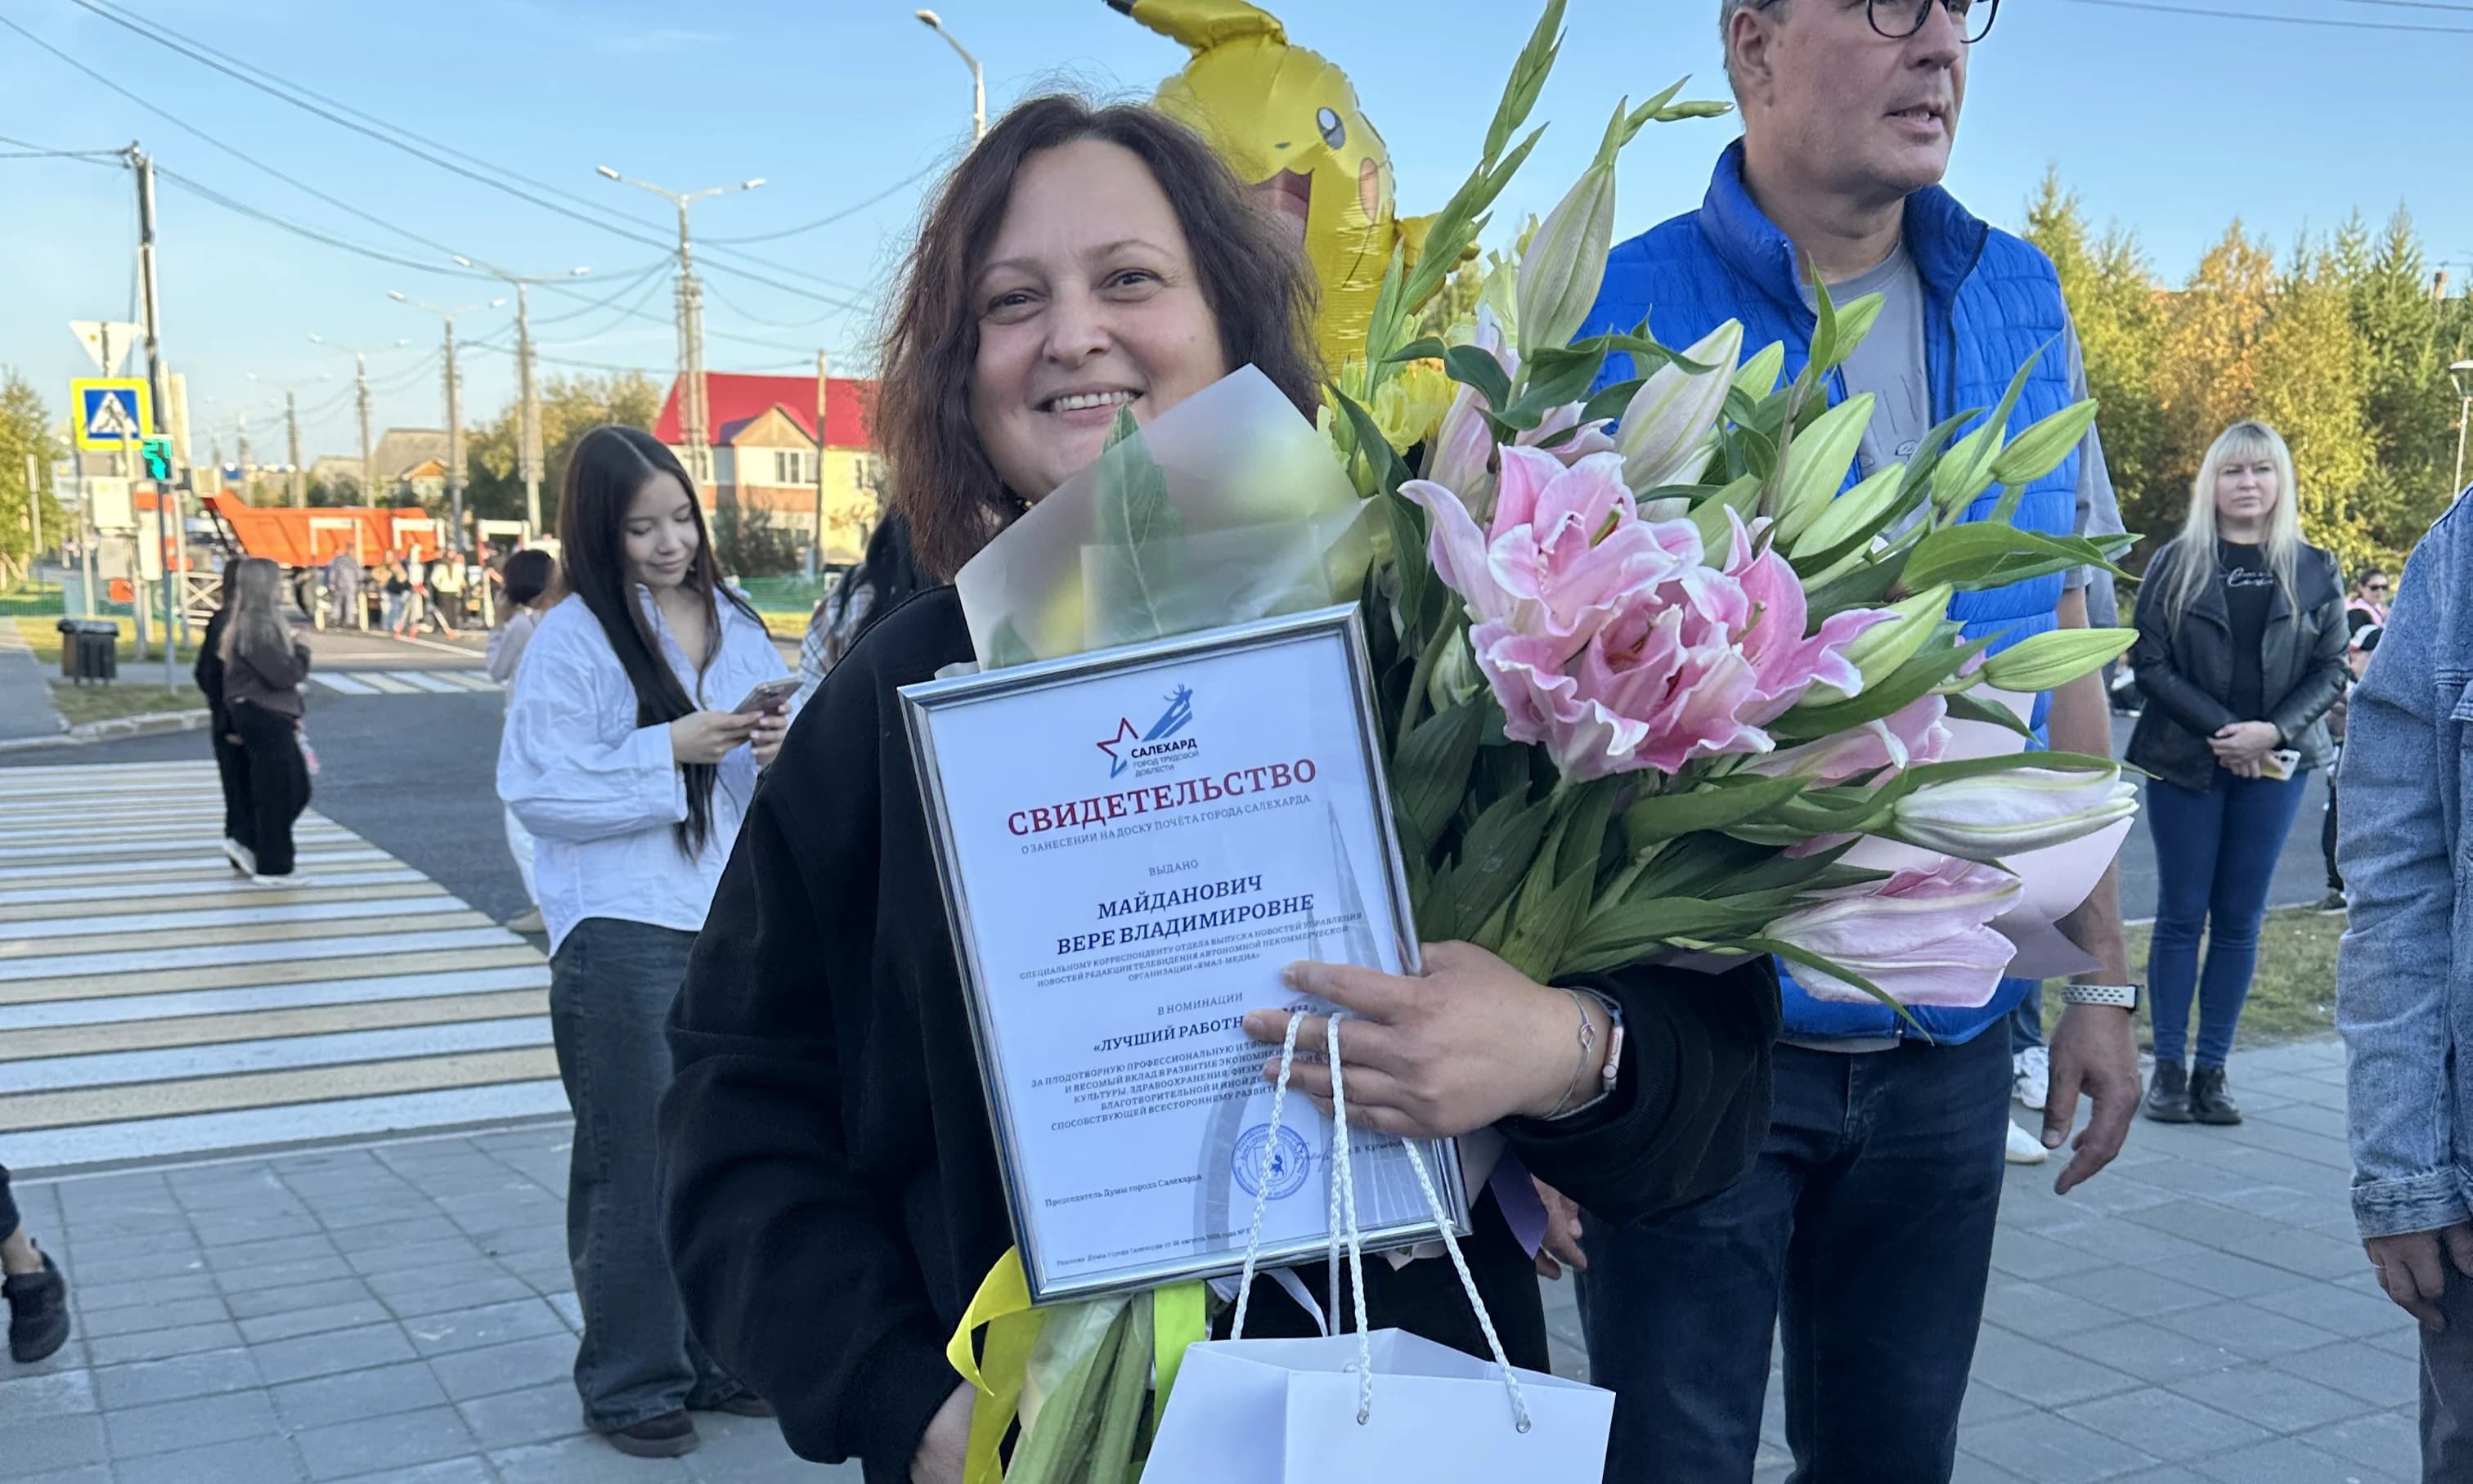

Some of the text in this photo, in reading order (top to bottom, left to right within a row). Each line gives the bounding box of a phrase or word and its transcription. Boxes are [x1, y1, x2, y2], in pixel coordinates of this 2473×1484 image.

[1130, 738, 1197, 758] САЛЕХАРД
[1132, 757, 1159, 768] ГОРОД
[1008, 759, 1315, 836] СВИДЕТЕЛЬСТВО
[1021, 845, 1029, 854] О
[1030, 832, 1097, 853] ЗАНЕСЕНИИ
[1099, 829, 1115, 840] НА
[1116, 823, 1151, 838] ДОСКУ
[1200, 805, 1243, 822] ГОРОДА
[1244, 793, 1311, 814] САЛЕХАРДА
[1148, 859, 1199, 877] ВЫДАНО
[1097, 874, 1261, 919] МАЙДАНОВИЧ
[1057, 894, 1313, 955] ВЕРЕ ВЛАДИМИРОВНЕ
[1019, 959, 1092, 980] СПЕЦИАЛЬНОМУ
[1093, 945, 1174, 967] КОРРЕСПОНДЕНТУ
[1174, 939, 1210, 952] ОТДЕЛА
[1210, 931, 1254, 946] ВЫПУСКА
[1254, 921, 1301, 938] НОВОСТЕЙ
[1037, 971, 1084, 988] НОВОСТЕЙ
[1262, 924, 1349, 947] НЕКОММЕРЧЕСКОЙ
[1156, 991, 1242, 1015] В НОМИНАЦИИ
[1093, 1015, 1243, 1051] «ЛУЧШИЙ РАБОТН
[1030, 1078, 1043, 1087] ЗА
[1044, 1064, 1125, 1085] ПЛОДОТВОРНУЮ
[1126, 1045, 1234, 1071] ПРОФЕССИОНАЛЬНУЮ
[1073, 1074, 1123, 1092] ВЕСОМЫЙ
[1124, 1070, 1157, 1083] ВКЛАД
[1165, 1059, 1217, 1076] РАЗВИТИЕ
[1050, 1083, 1277, 1131] СПОСОБСТВУЮЩЕЙ ВСЕСТОРОННЕМУ РАЗВИТ
[1100, 1083, 1210, 1110] БЛАГОТВОРИТЕЛЬНОЙ
